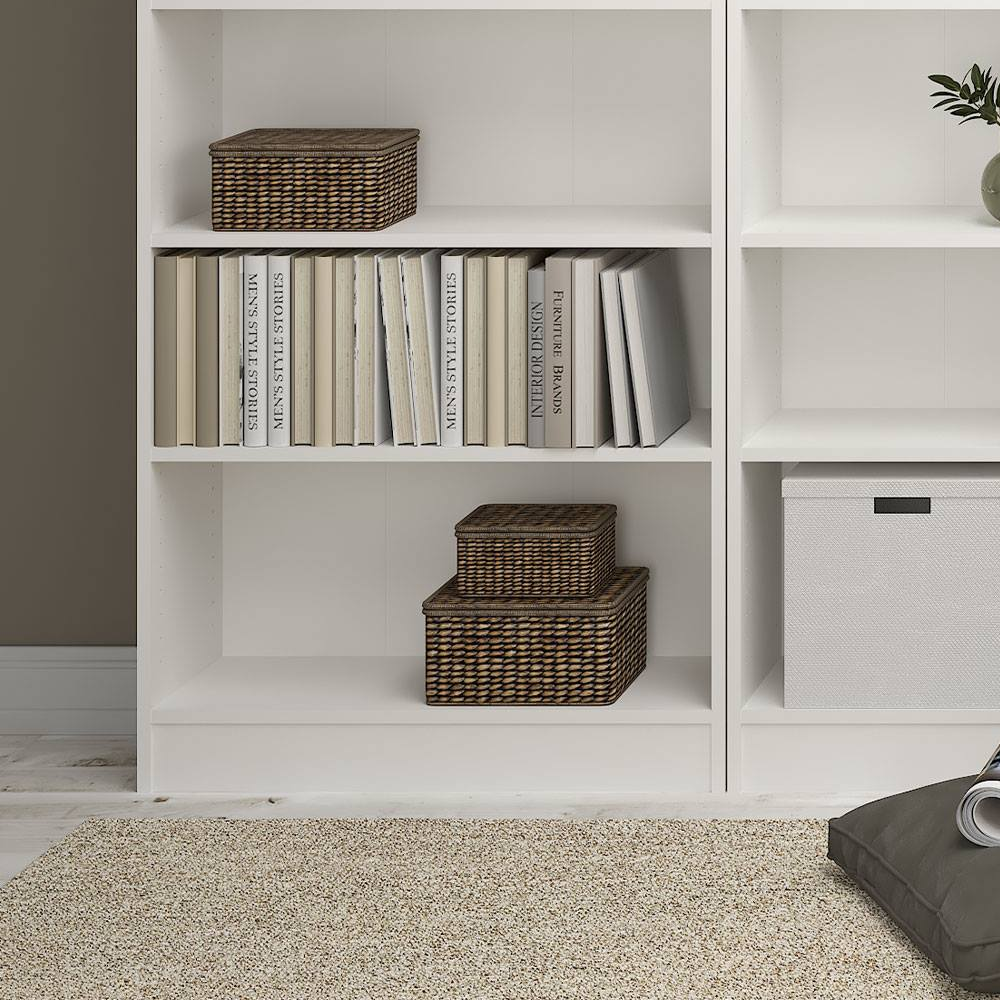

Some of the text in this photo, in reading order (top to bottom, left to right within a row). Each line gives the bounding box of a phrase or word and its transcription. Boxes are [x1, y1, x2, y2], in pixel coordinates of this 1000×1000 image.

[248, 273, 257, 431] MEN'S STYLE STORIES
[273, 272, 283, 430] MEN'S STYLE STORIES
[446, 273, 456, 430] MEN'S STYLE STORIES
[531, 302, 543, 418] INTERIOR DESIGN
[553, 290, 563, 415] FURNITURE BRANDS
